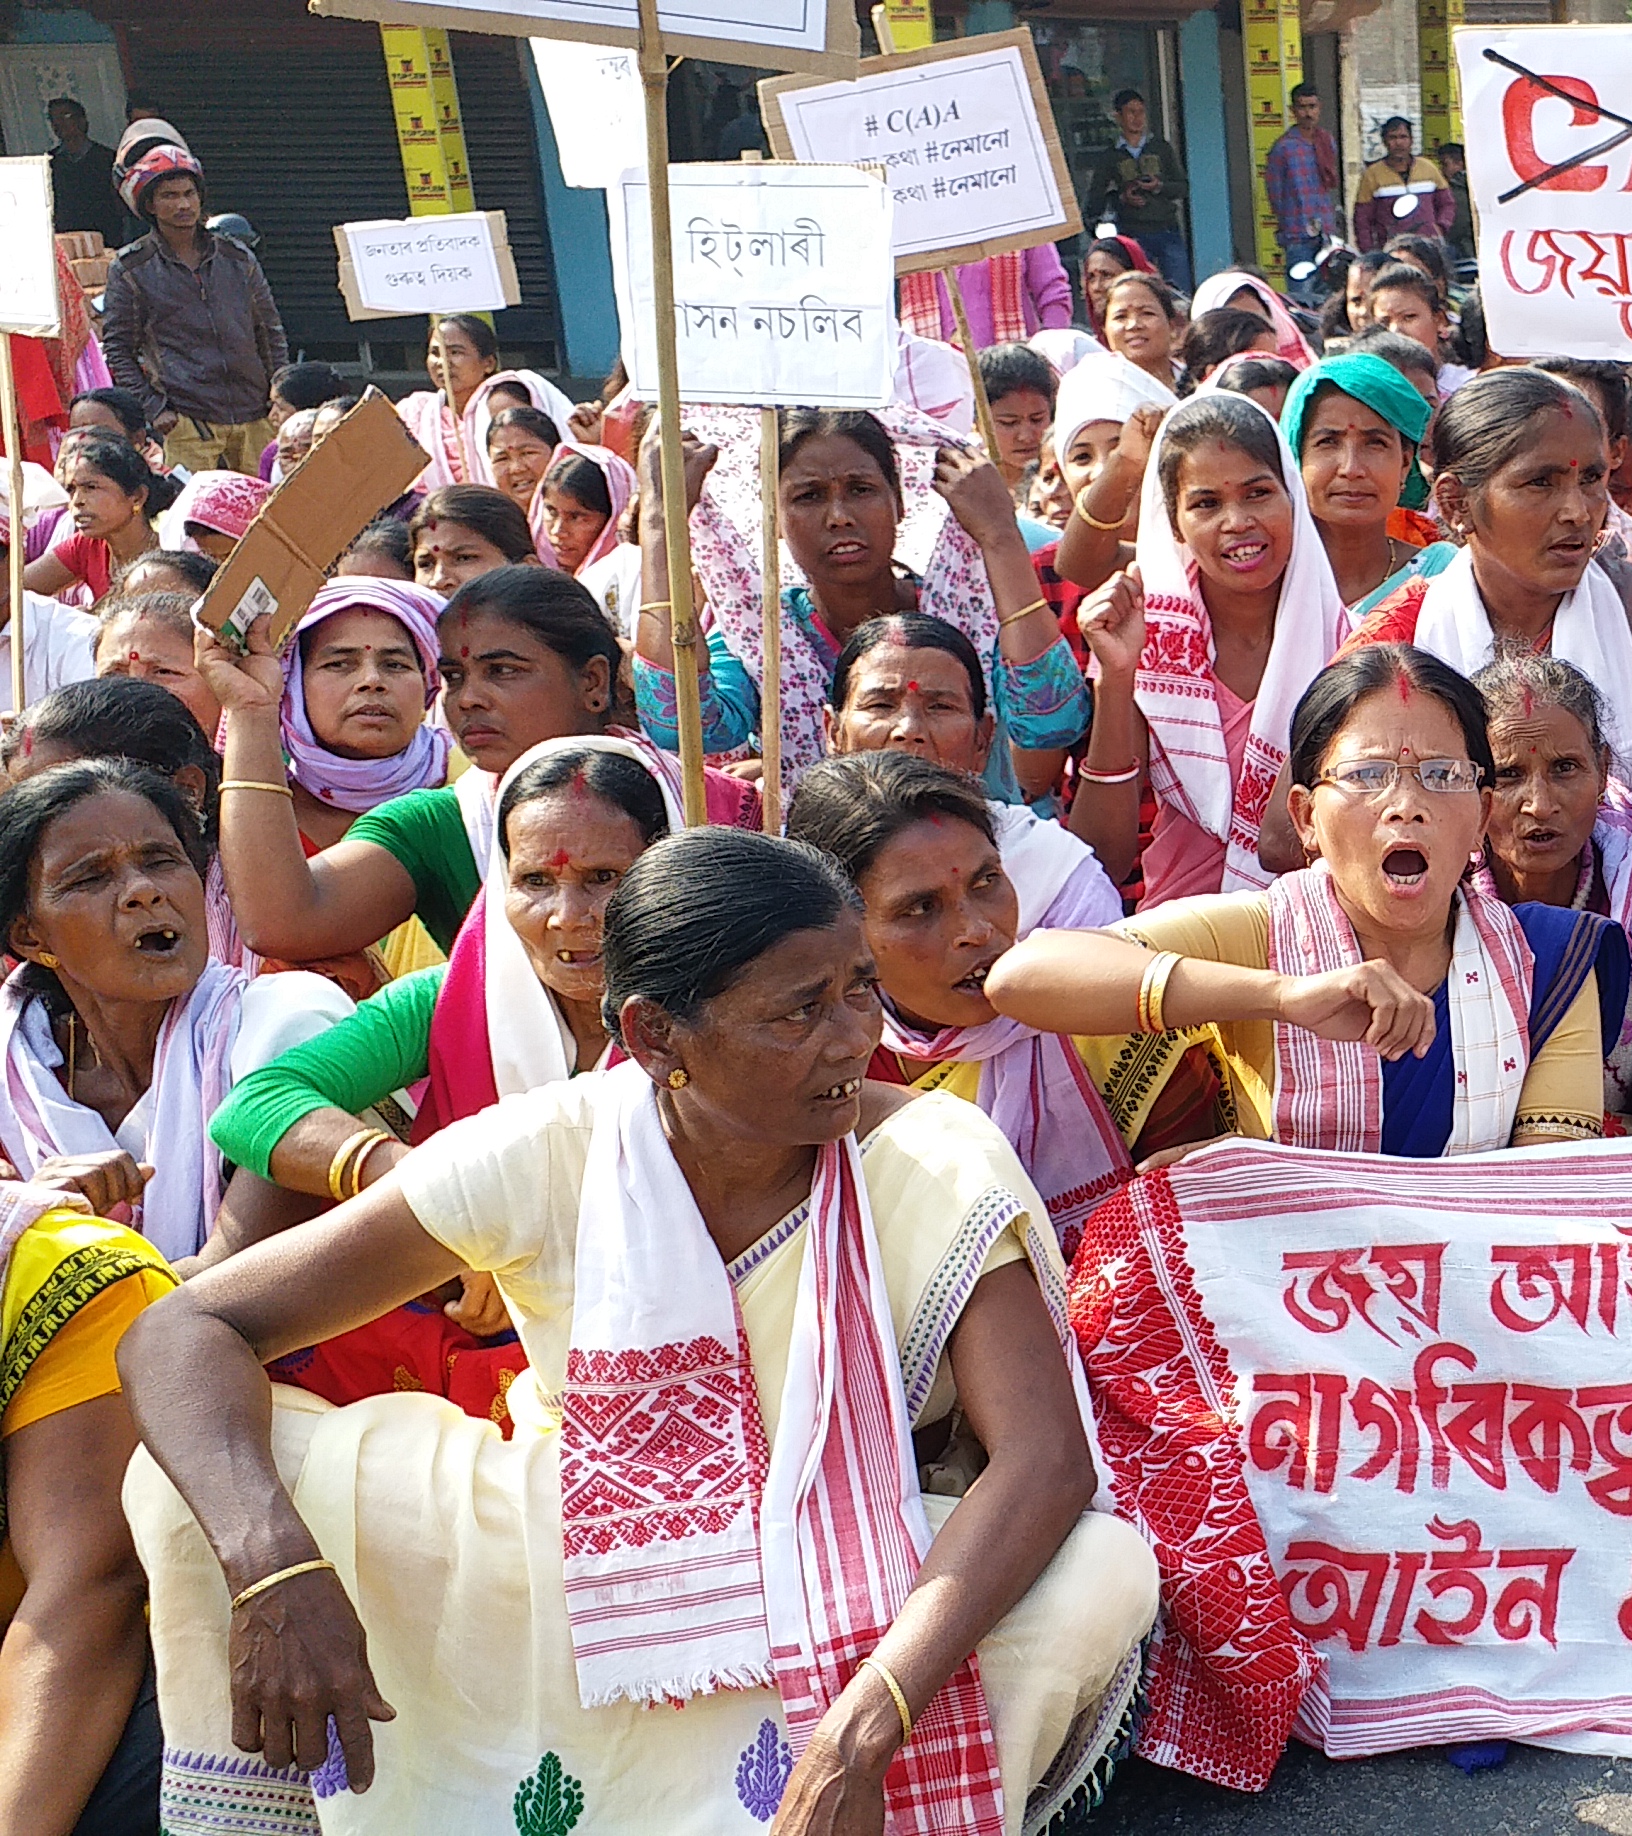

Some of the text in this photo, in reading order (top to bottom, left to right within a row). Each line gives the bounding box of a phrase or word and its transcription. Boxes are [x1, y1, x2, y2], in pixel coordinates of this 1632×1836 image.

[886, 99, 961, 137] C(A)A
[673, 301, 738, 339] াসন
[1277, 1513, 1578, 1652] আইন
